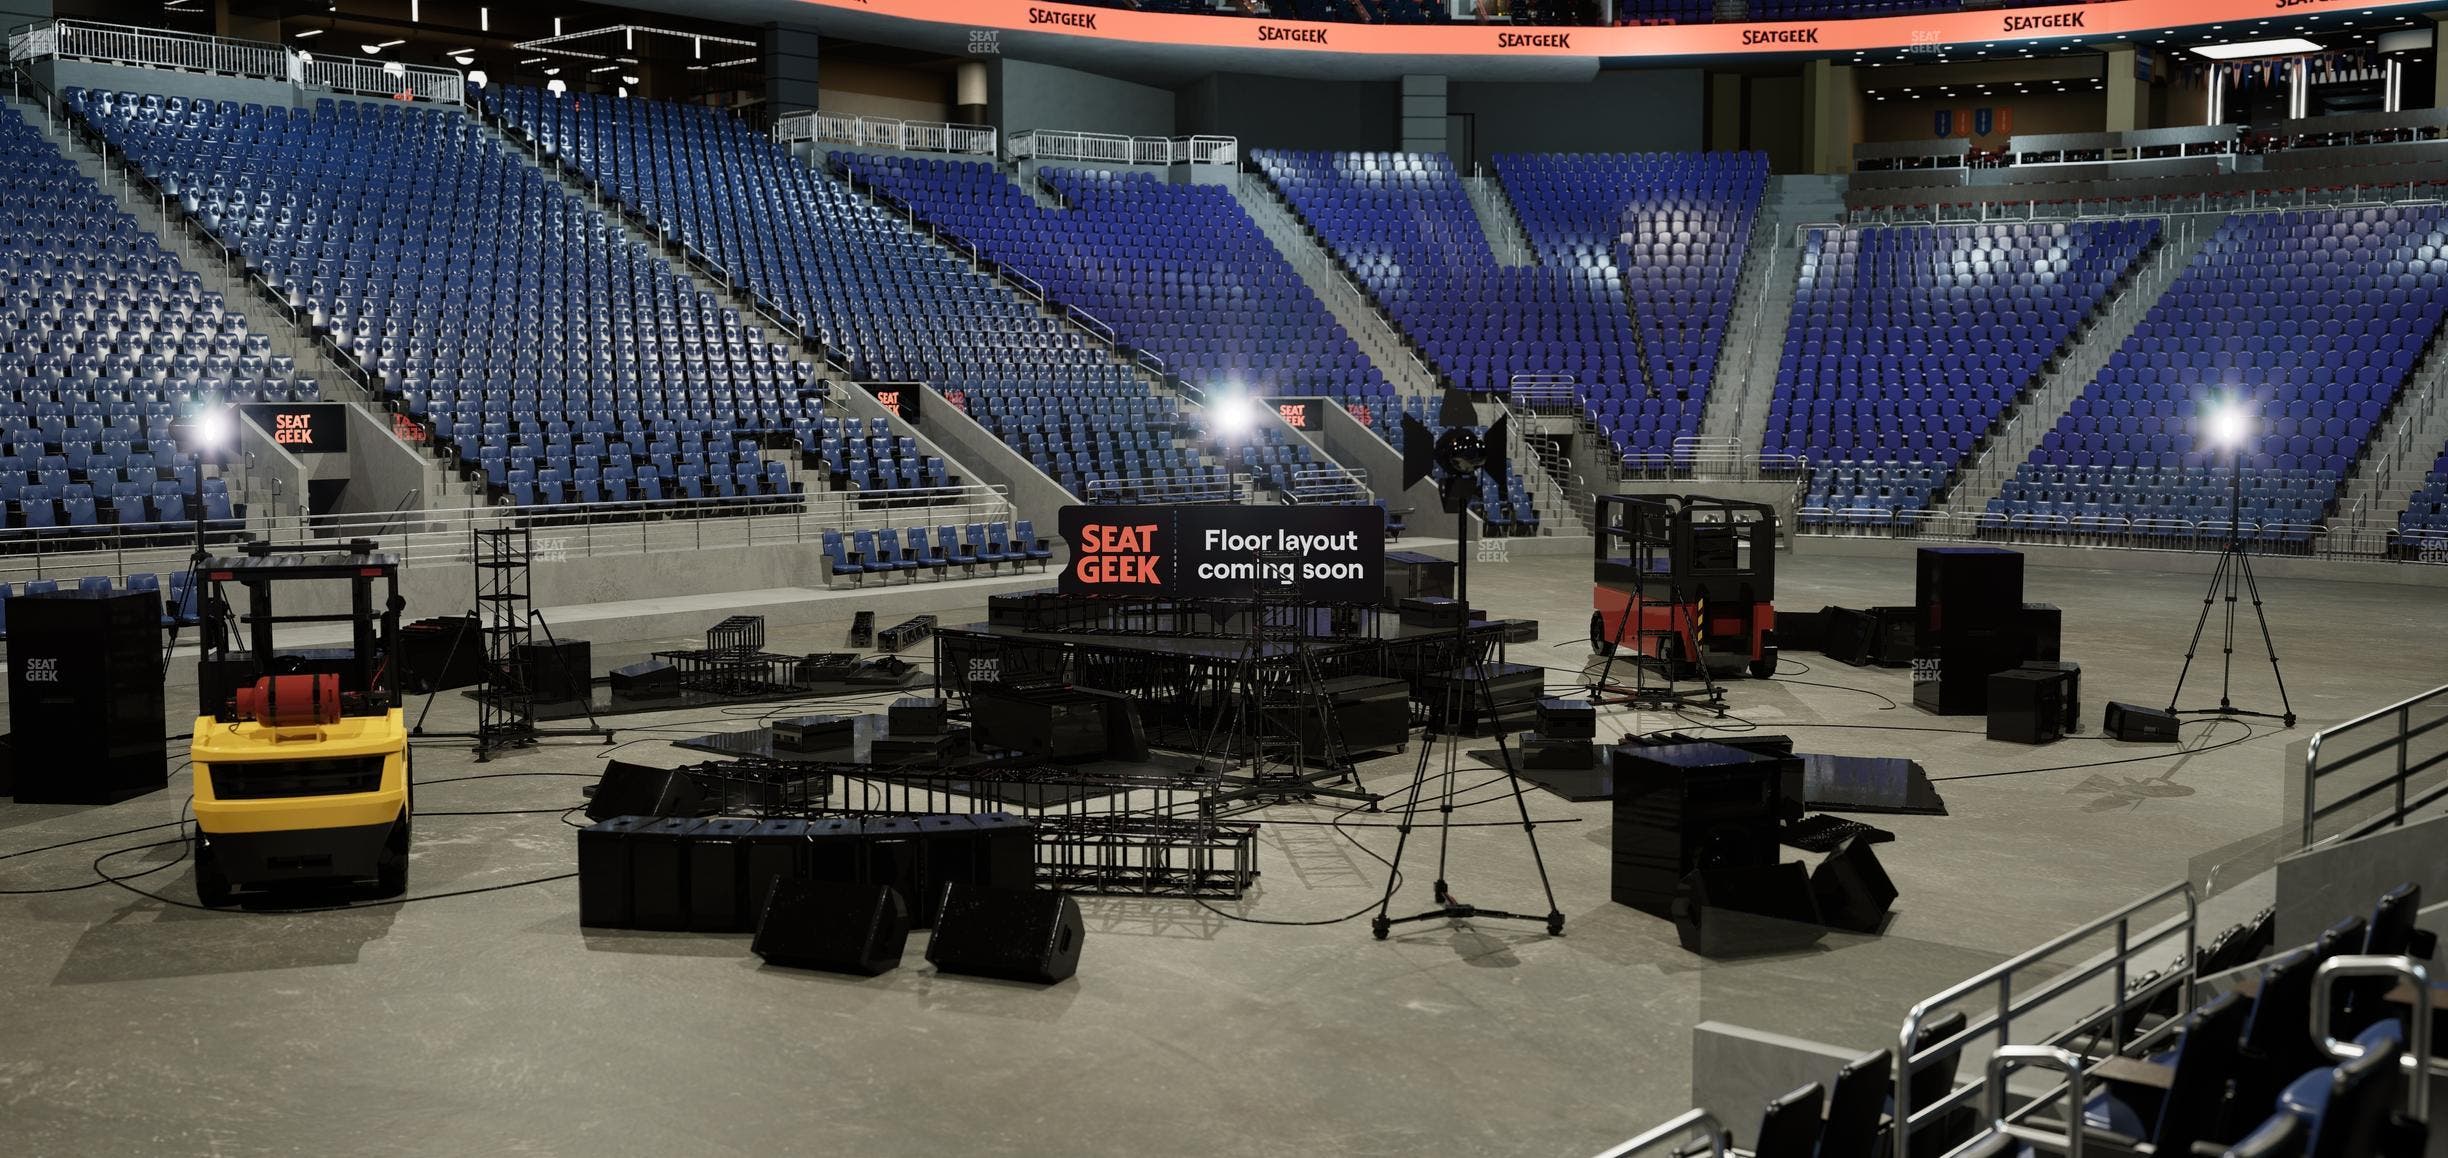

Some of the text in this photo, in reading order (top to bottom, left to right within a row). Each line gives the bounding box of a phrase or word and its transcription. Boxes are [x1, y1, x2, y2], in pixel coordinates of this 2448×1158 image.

[1029, 7, 1096, 30] SEATGEEK
[2003, 11, 2084, 32] SEATGEEK
[1258, 25, 1328, 44] SEATGEEK
[1498, 33, 1570, 48] SEATGEEK
[1742, 28, 1818, 45] SEATGEEK
[877, 391, 900, 404] SEAT
[1280, 405, 1305, 415] SEAT
[276, 414, 311, 428] SEAT
[274, 429, 313, 444] GEEK
[1081, 524, 1158, 554] SEAT
[1205, 529, 1358, 556] Floor layout
[1076, 555, 1161, 585] GEEK
[1198, 559, 1363, 585] coming soon
